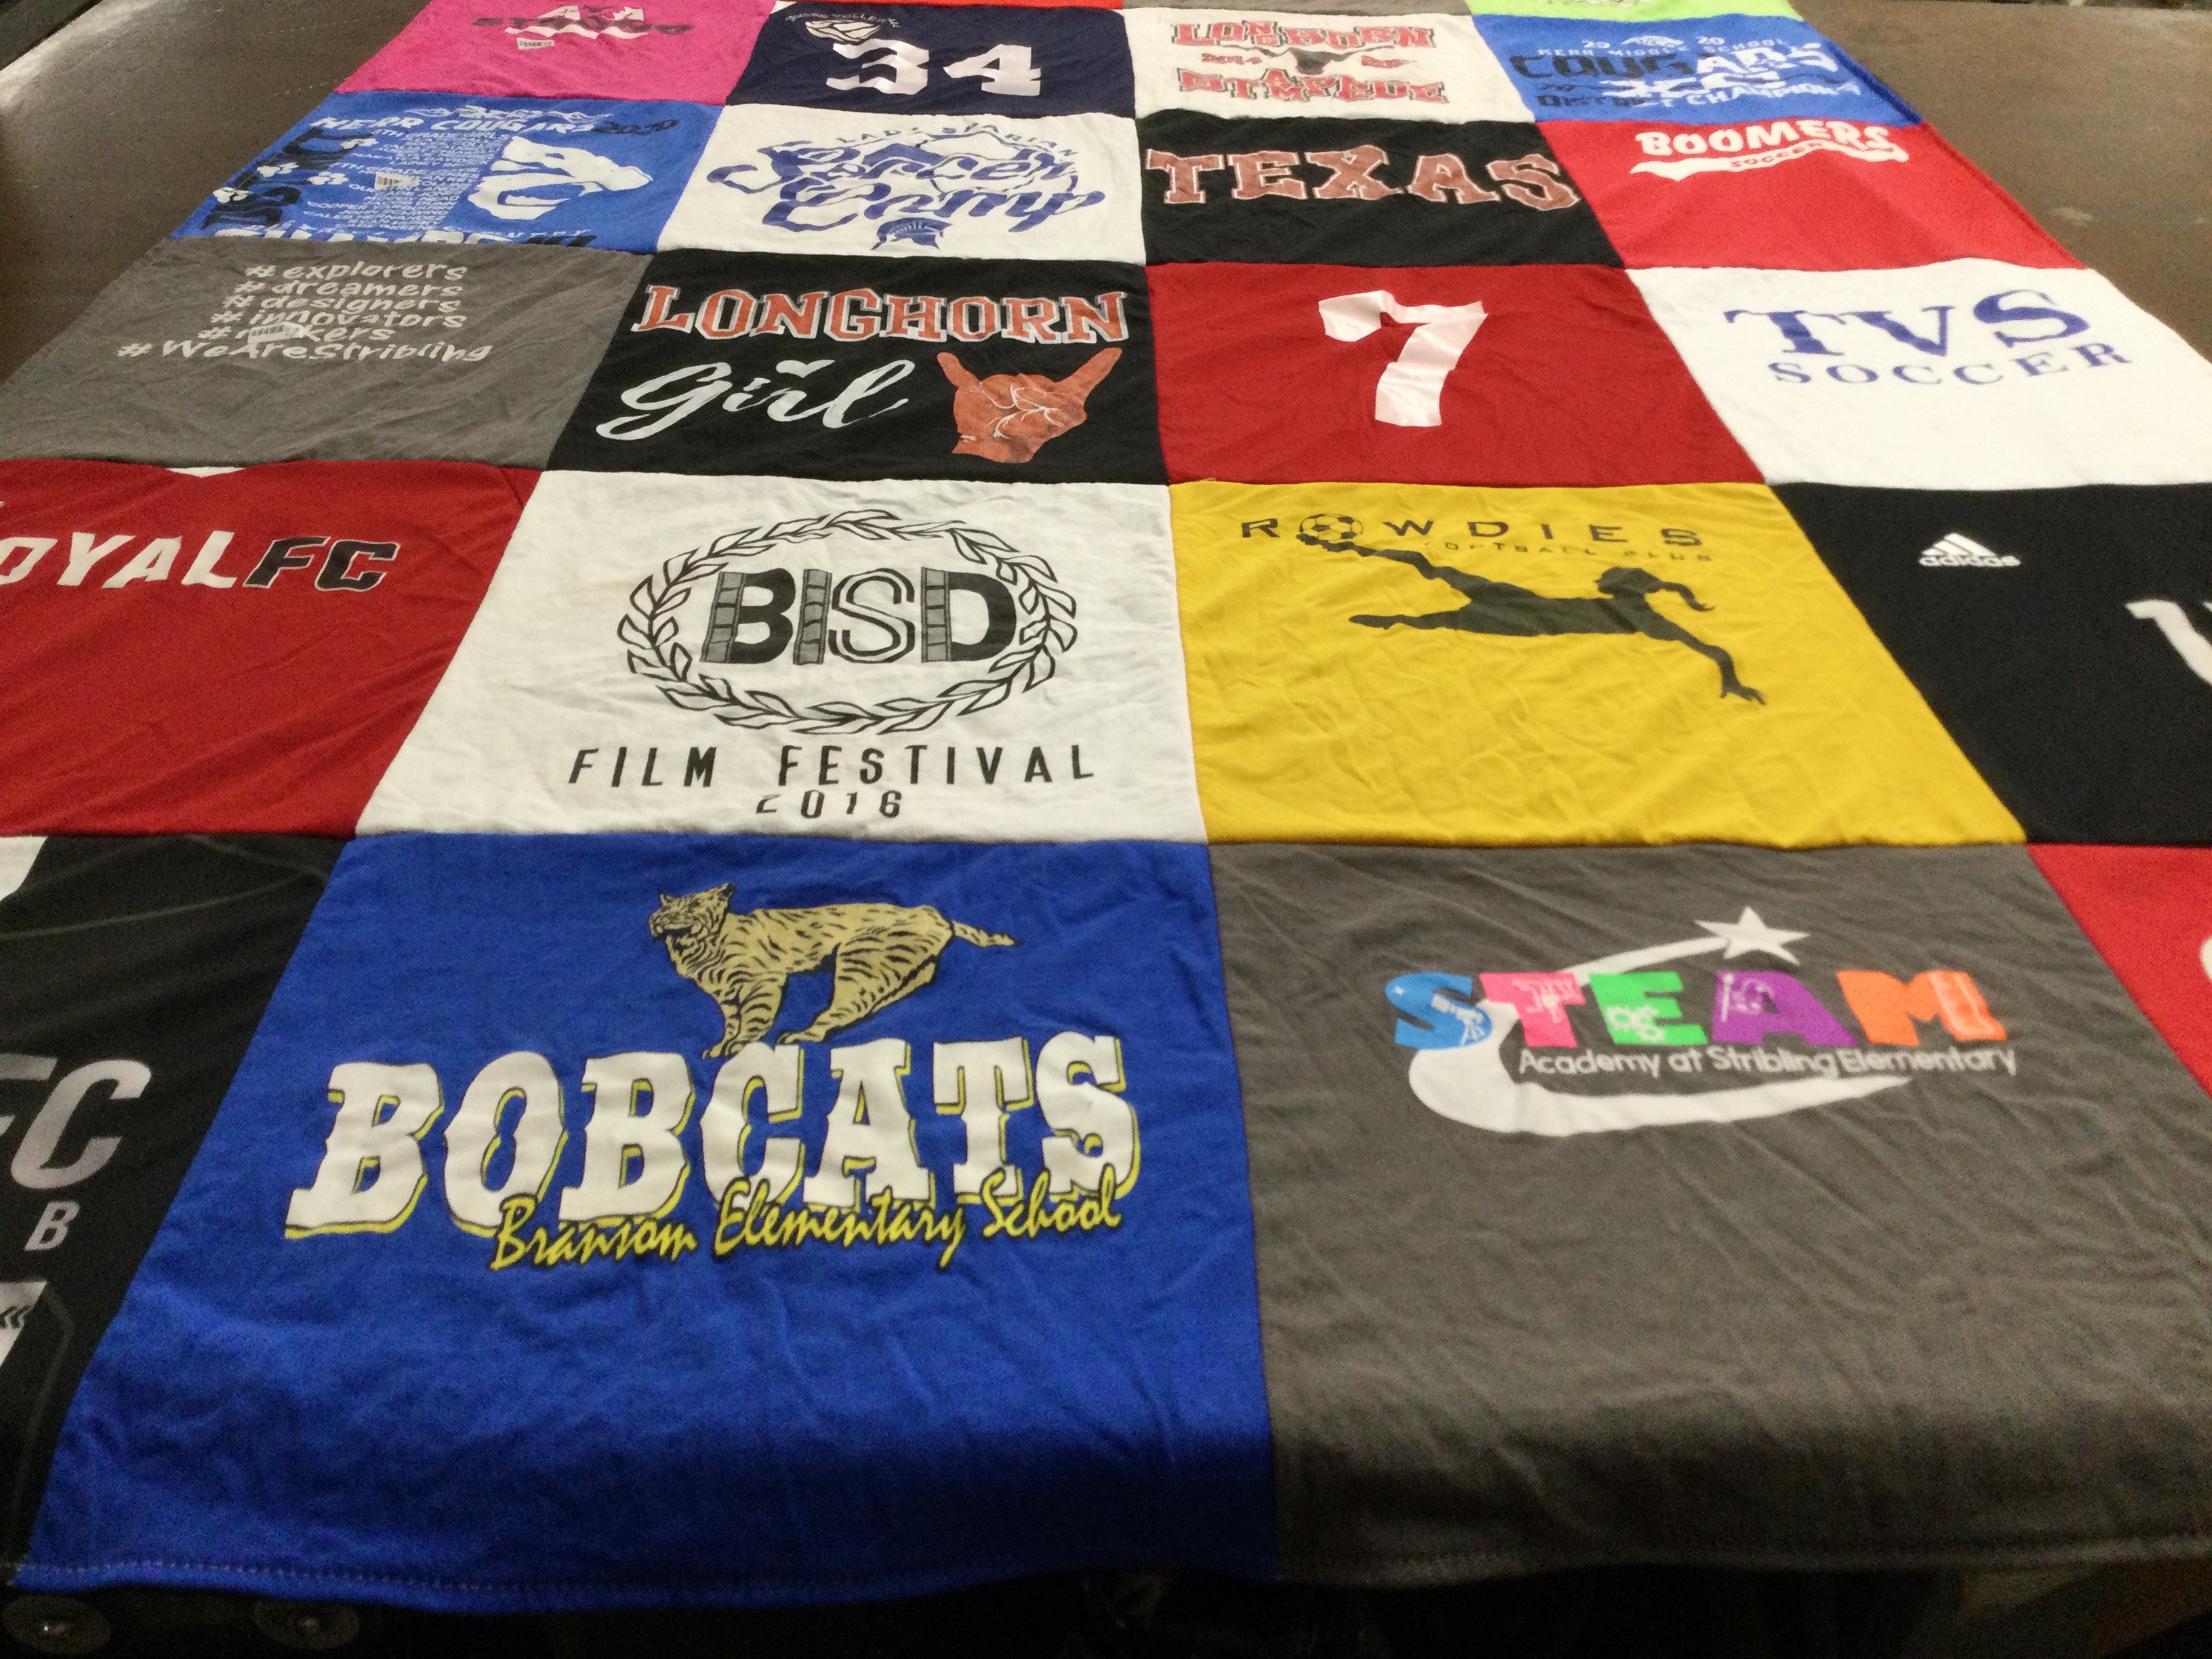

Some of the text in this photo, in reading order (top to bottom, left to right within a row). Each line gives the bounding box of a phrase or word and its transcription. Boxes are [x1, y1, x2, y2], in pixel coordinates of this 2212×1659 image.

[1170, 20, 1437, 50] LONGHORN
[826, 39, 1042, 96] 34
[1635, 119, 1898, 157] BOOMERS
[1146, 144, 1582, 211] TEXAS
[198, 323, 395, 342] #kers
[630, 285, 1130, 344] LONGHORN
[1723, 289, 2091, 357] TVS
[1318, 290, 1488, 427] 7
[1767, 342, 2133, 385] SOCCER
[1241, 512, 1704, 548] ROWDIES
[699, 567, 1017, 665] BISD
[568, 744, 1095, 789] FILM FESTIVAL
[754, 789, 903, 819] 2016
[1384, 970, 2009, 1050] STEAM
[1517, 1047, 2018, 1079] Academy at Stribling Elementary
[285, 1030, 1141, 1240] BOBCATS
[712, 1175, 967, 1273] Elementary
[979, 1162, 1122, 1240] School
